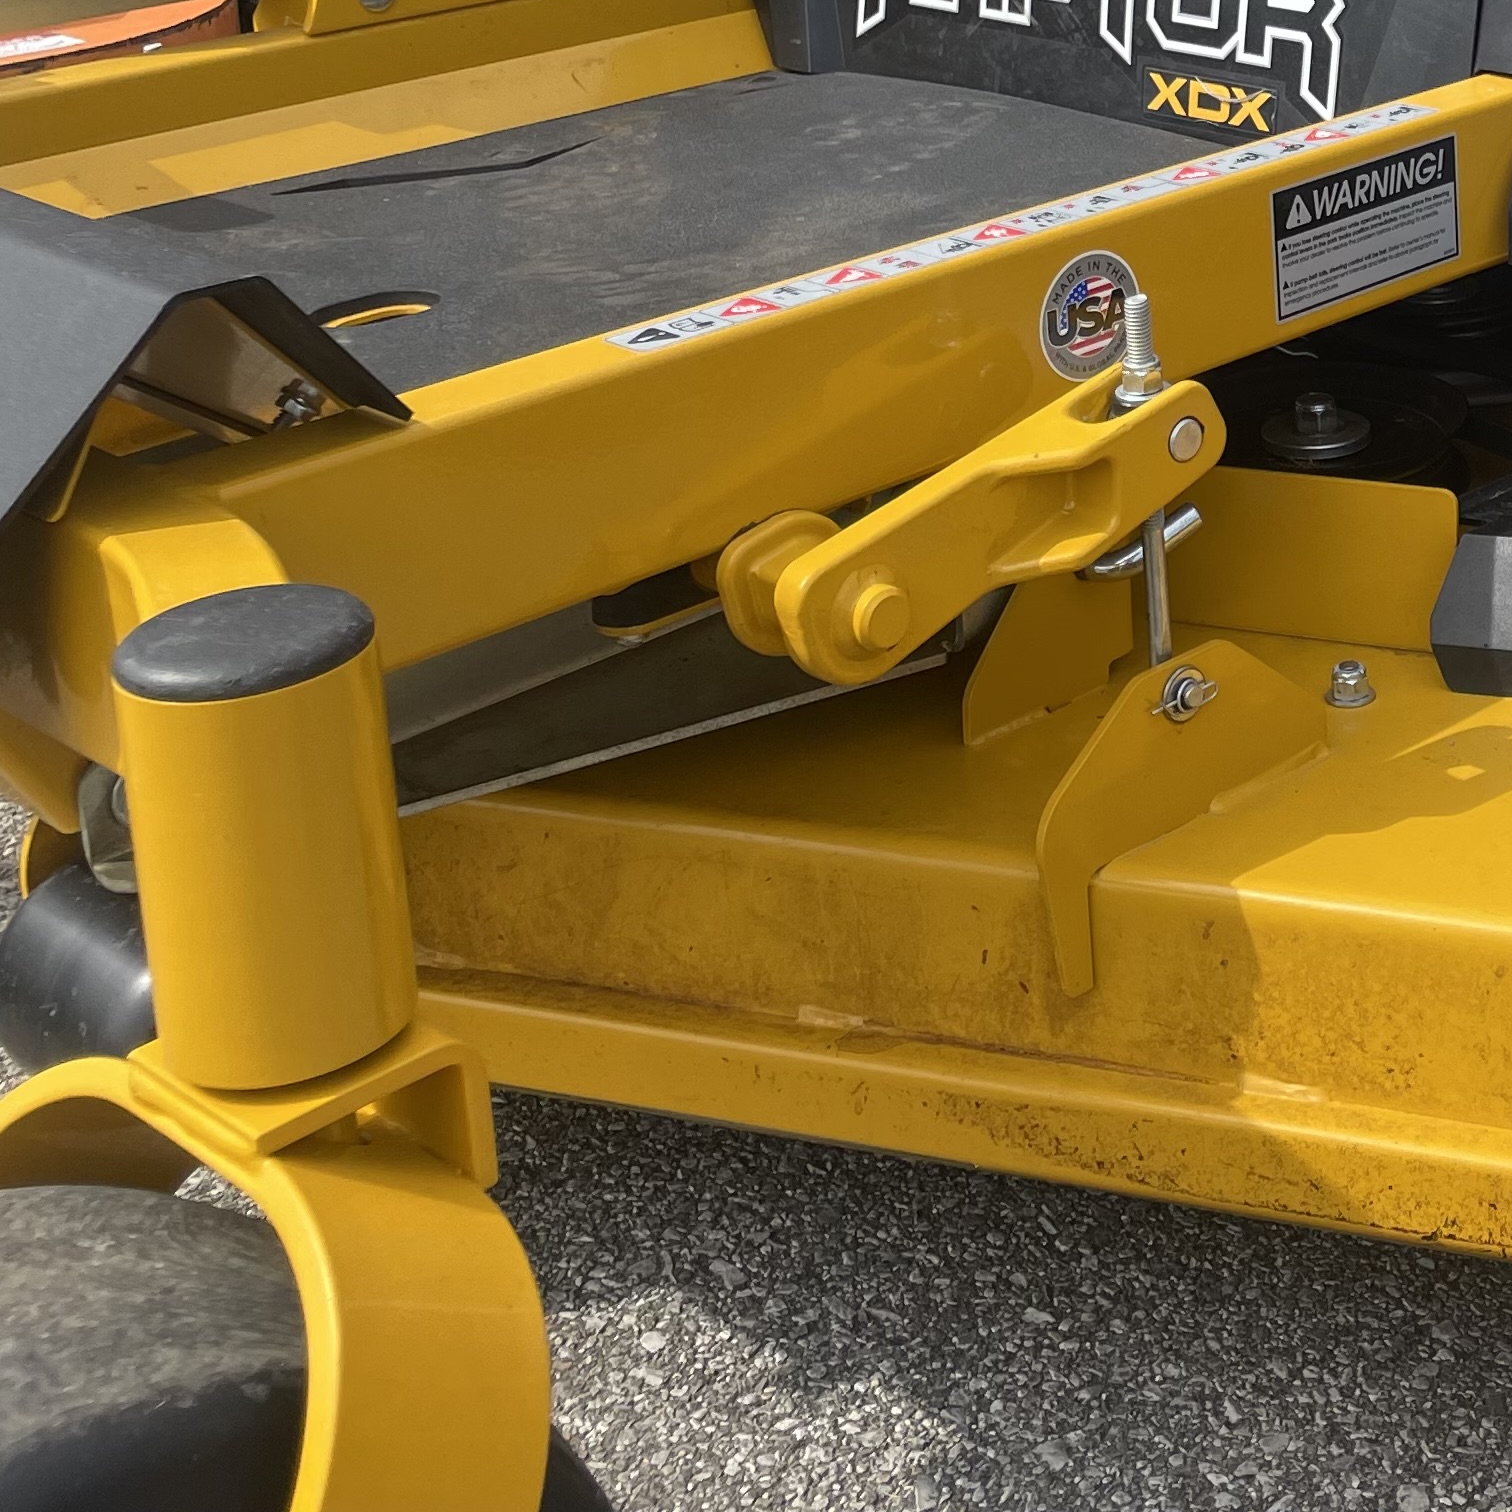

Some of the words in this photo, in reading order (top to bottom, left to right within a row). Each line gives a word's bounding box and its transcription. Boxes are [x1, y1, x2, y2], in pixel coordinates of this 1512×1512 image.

[1146, 71, 1273, 133] XDX
[1313, 149, 1445, 220] WARNING!
[1052, 265, 1084, 305] MADE
[1087, 260, 1101, 273] IN
[1105, 262, 1126, 285] THE
[1047, 288, 1125, 347] USA
